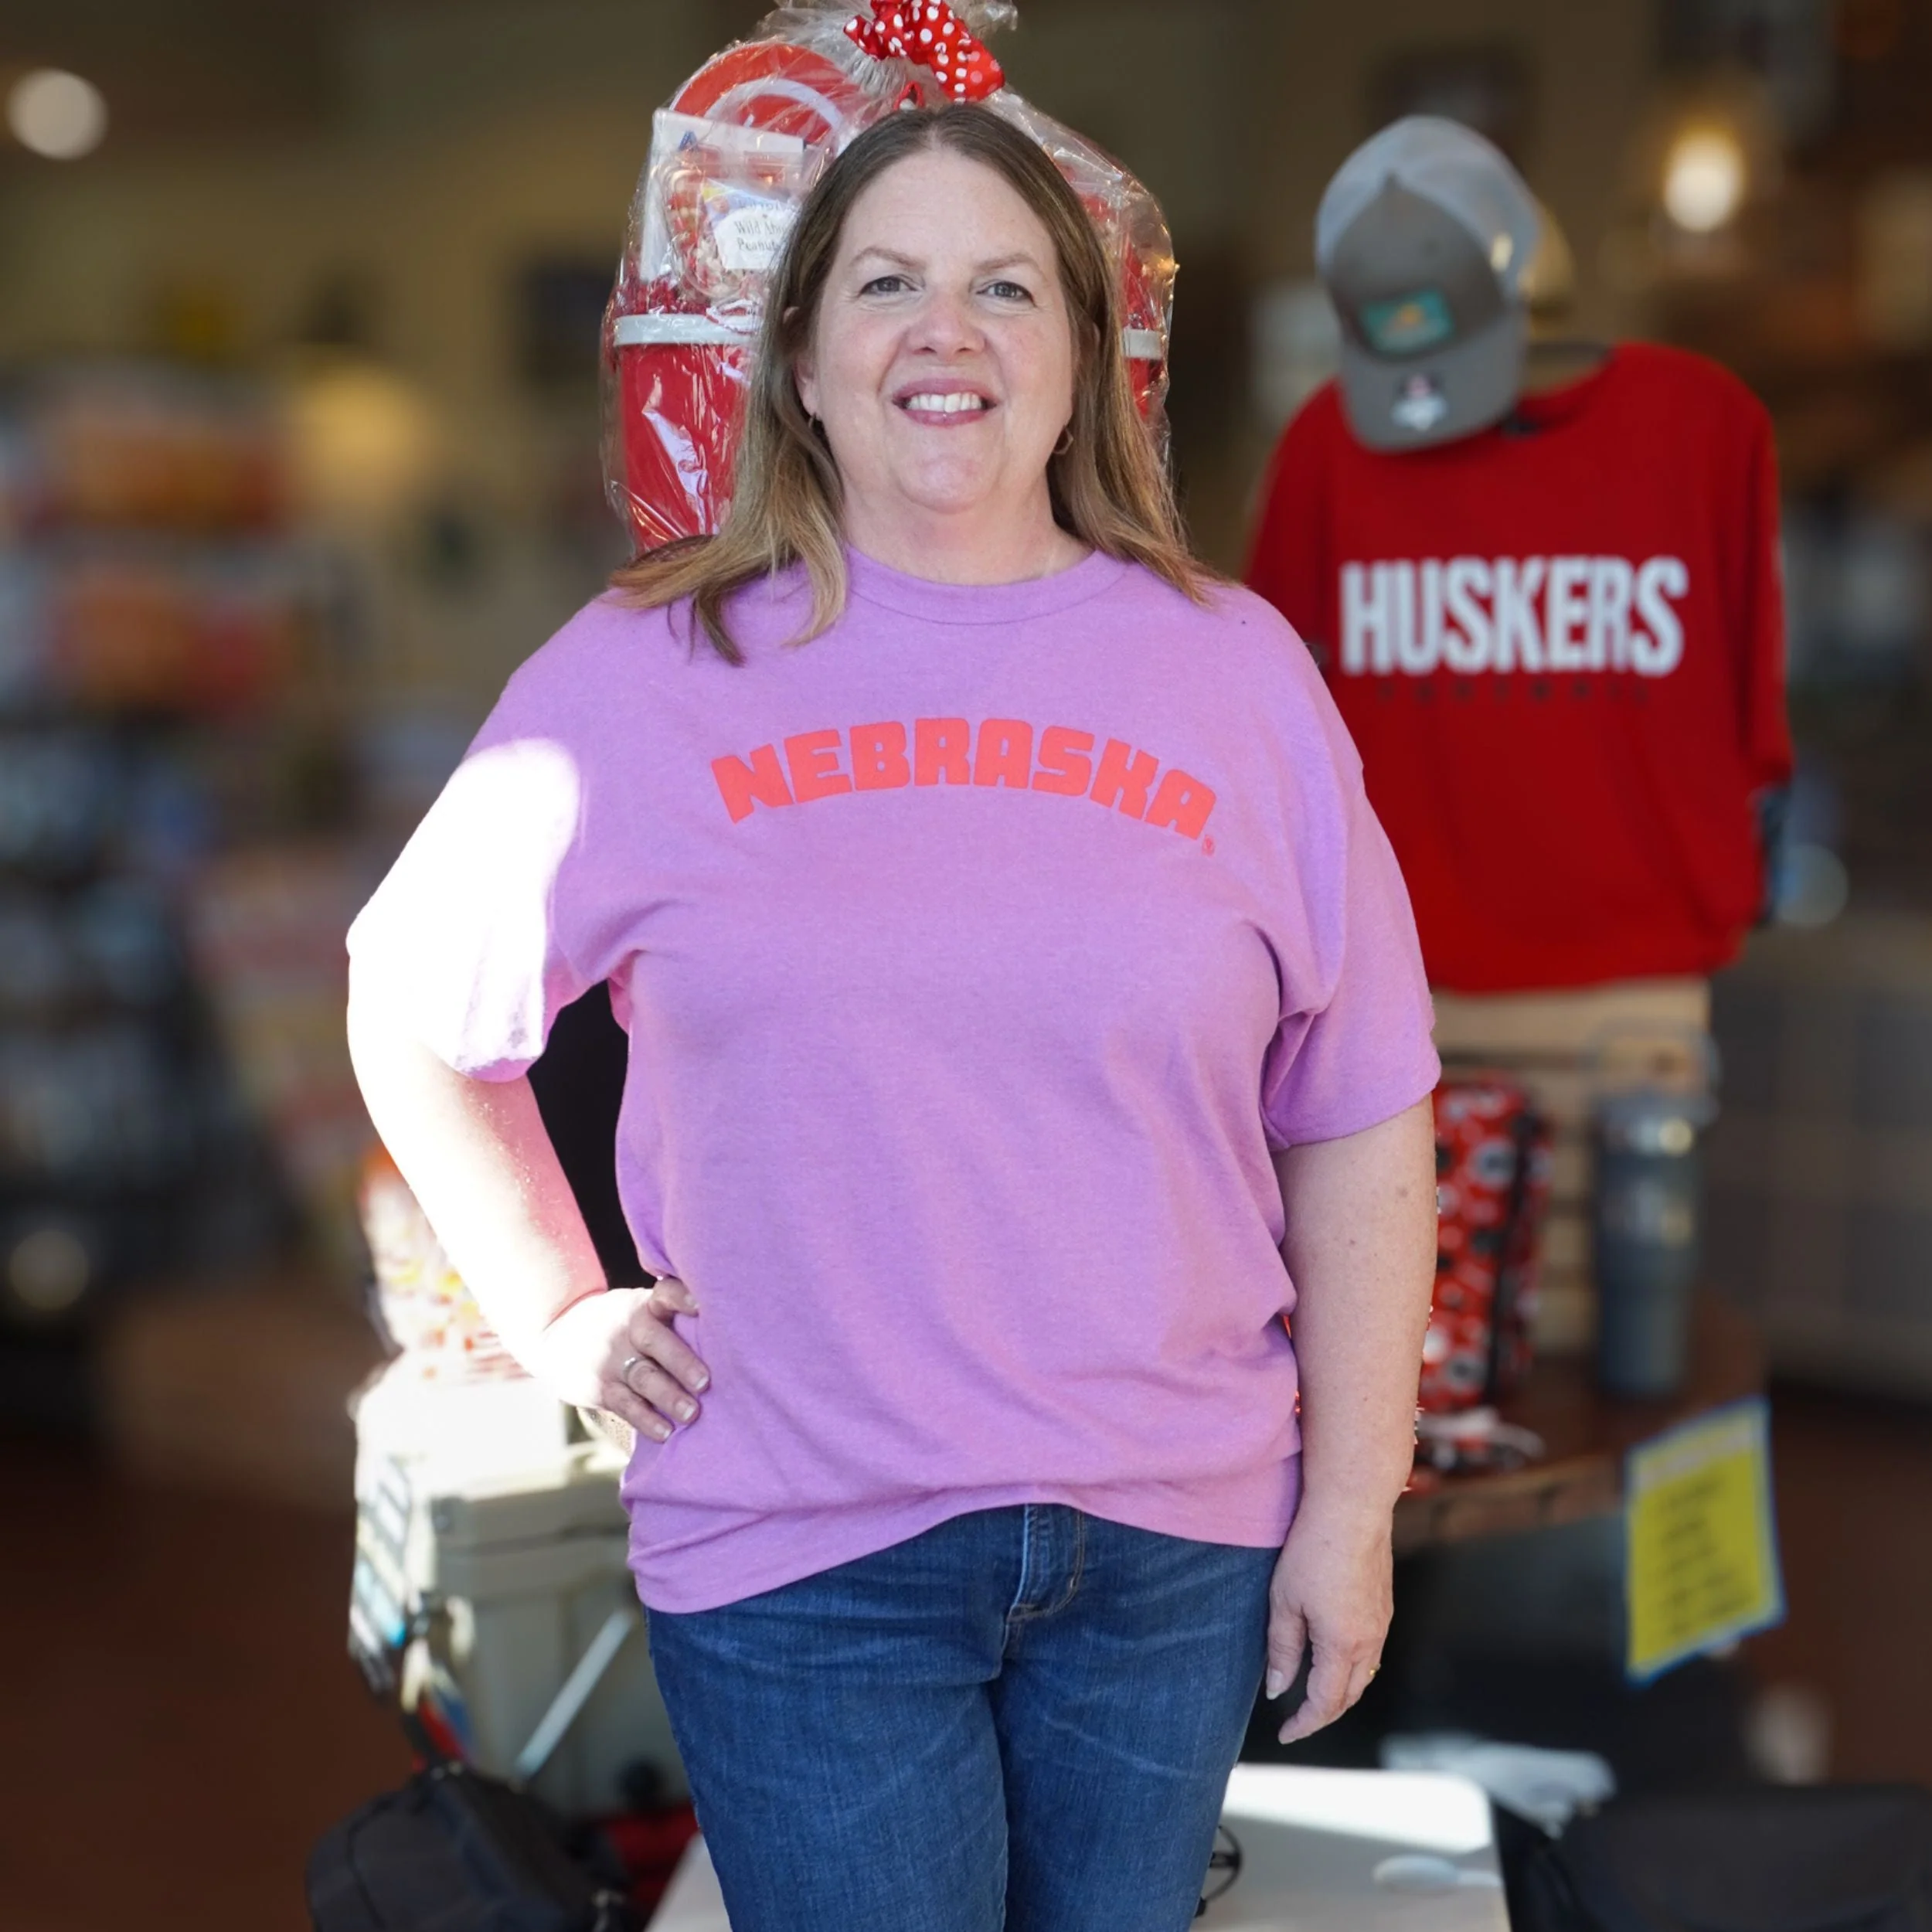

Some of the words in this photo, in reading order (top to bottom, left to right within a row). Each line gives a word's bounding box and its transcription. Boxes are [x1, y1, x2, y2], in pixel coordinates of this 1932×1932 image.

[736, 236, 779, 251] Peanut
[1340, 555, 1689, 677] HUSKERS
[711, 717, 1217, 840] NEBRASKA
